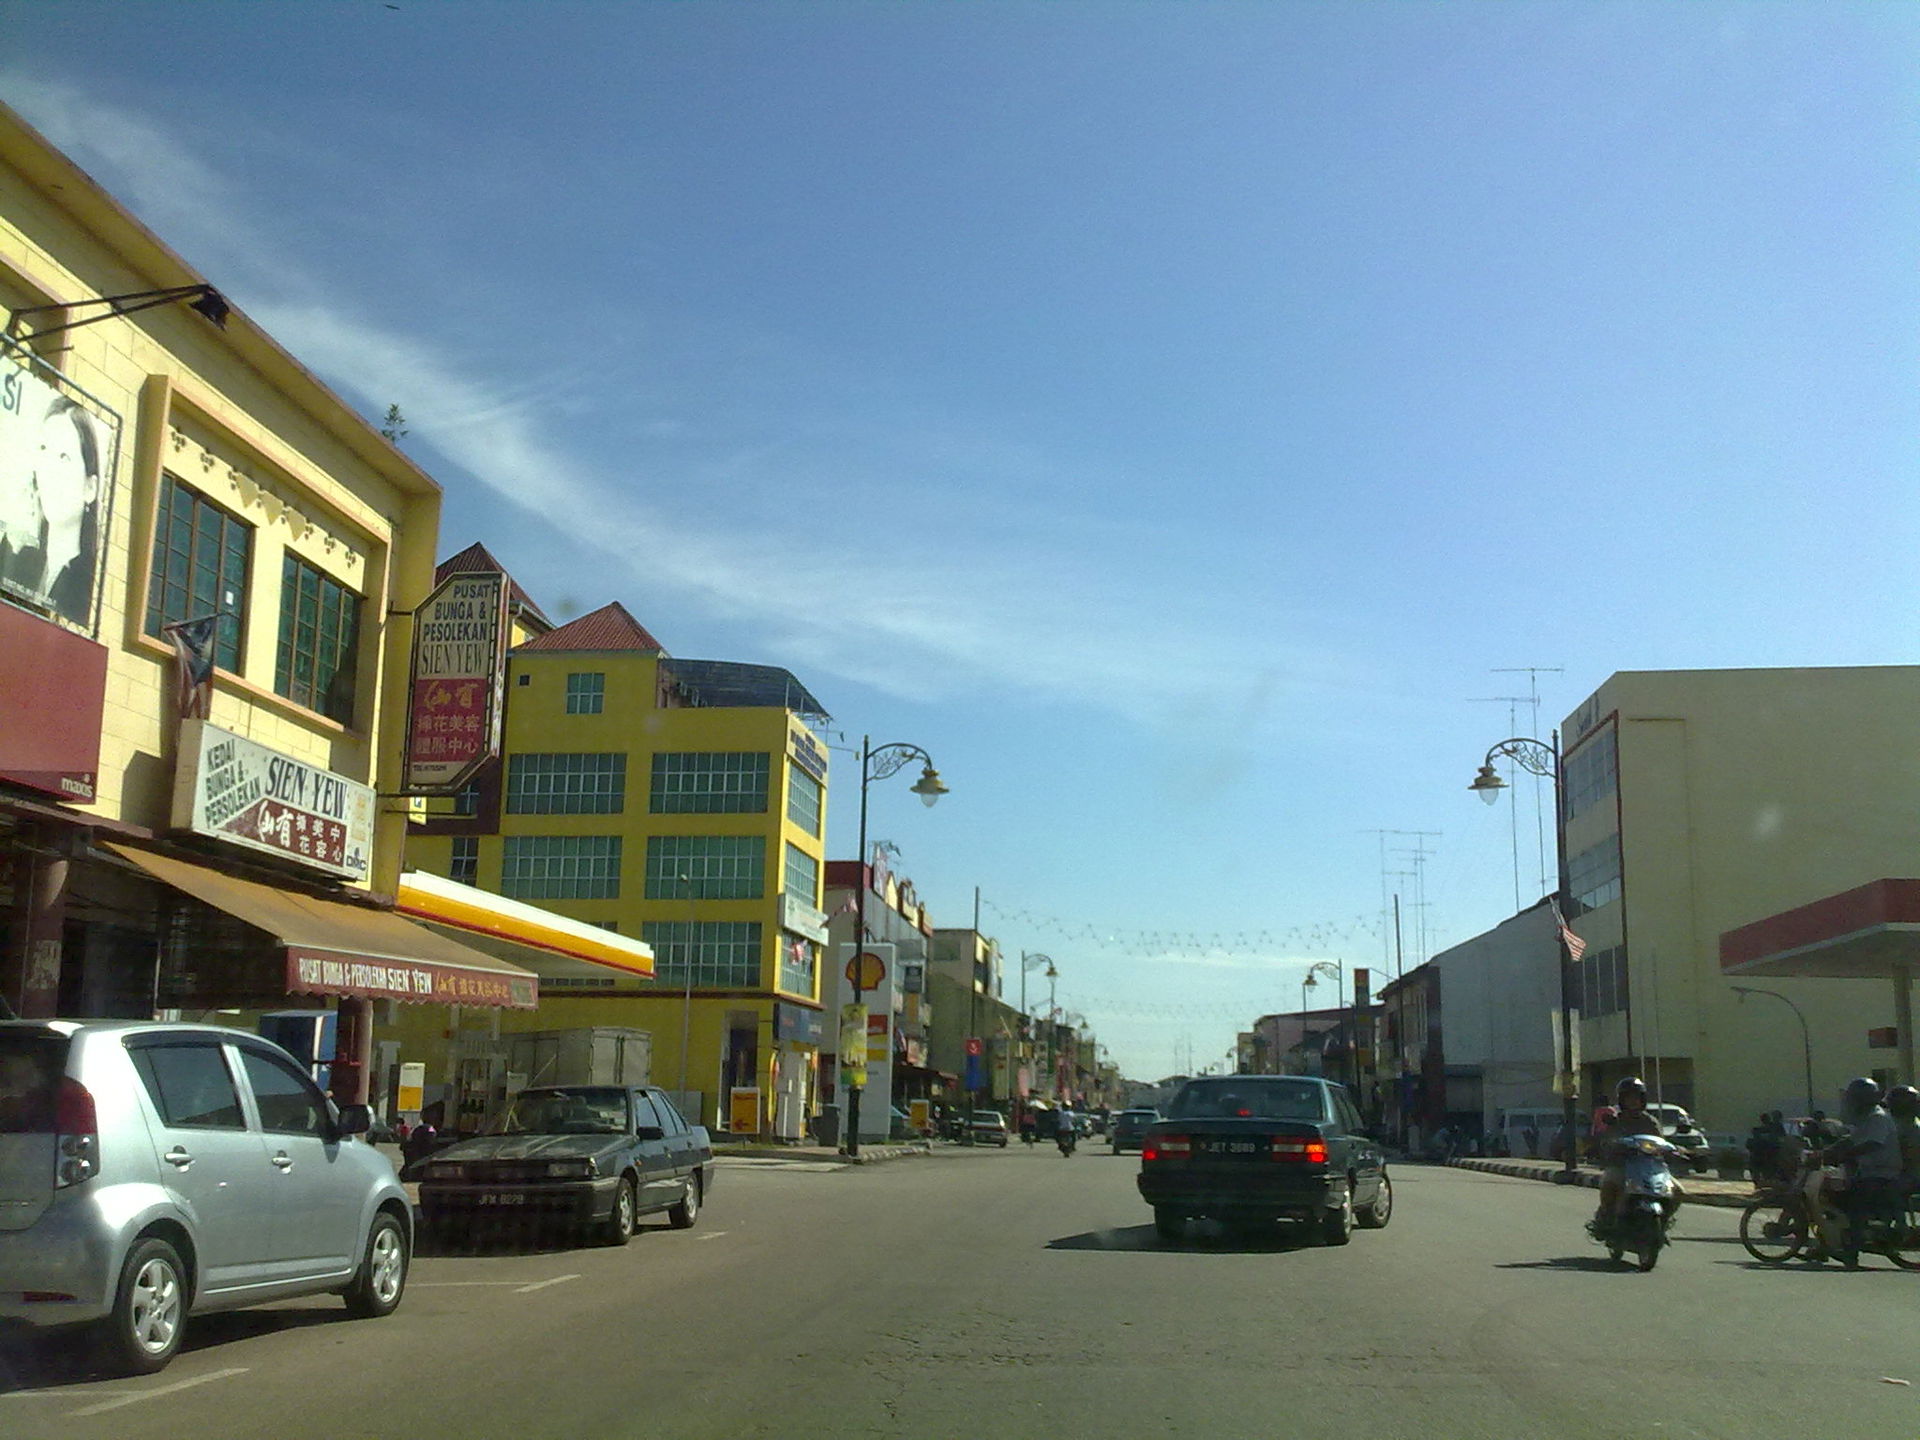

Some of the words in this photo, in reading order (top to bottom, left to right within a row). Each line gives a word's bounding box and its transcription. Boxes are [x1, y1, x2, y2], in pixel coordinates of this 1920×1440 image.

[453, 584, 491, 598] PUSAT
[434, 601, 473, 620] BUNGA
[478, 601, 487, 620] &
[422, 622, 488, 641] PESOLEKAN
[421, 643, 452, 675] SIEN
[456, 643, 486, 674] YEW
[206, 738, 235, 772] KEDAI
[205, 763, 236, 800] BUNGA
[237, 760, 245, 782] &
[265, 756, 308, 806] SIEN
[312, 773, 348, 820] YEW
[205, 776, 261, 829] PERSOLEKAN
[387, 967, 410, 992] SIEN
